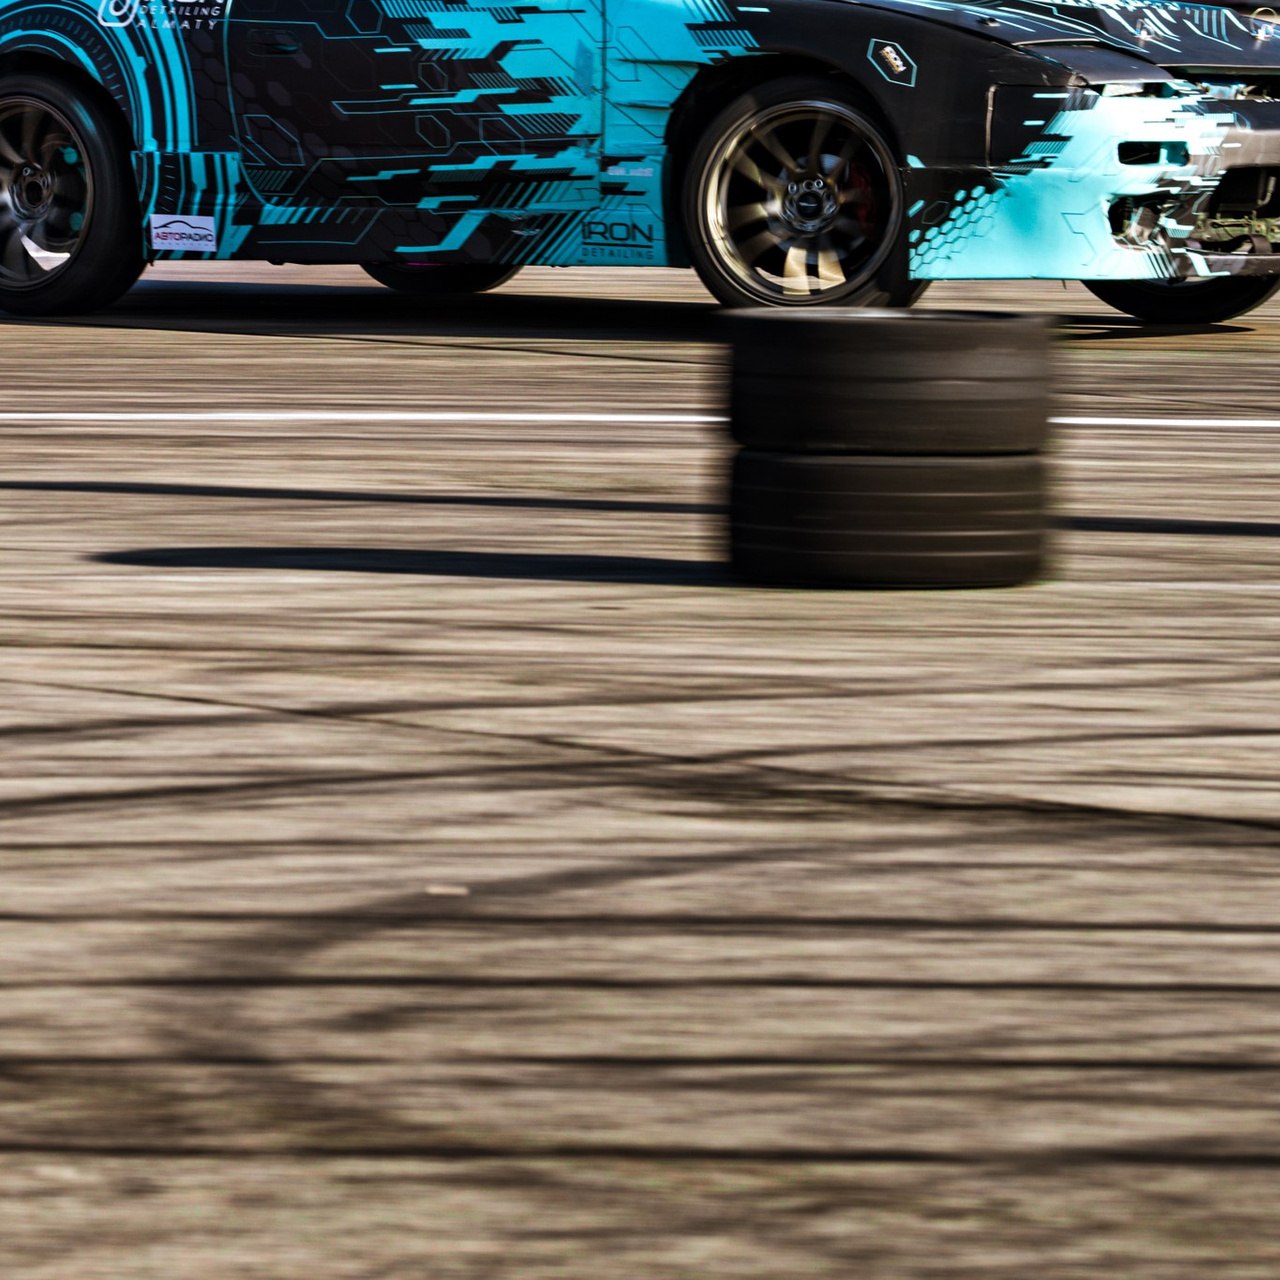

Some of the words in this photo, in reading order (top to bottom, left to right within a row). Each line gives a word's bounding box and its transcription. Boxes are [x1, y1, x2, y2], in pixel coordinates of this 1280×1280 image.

[139, 5, 221, 16] DETAILING
[136, 19, 218, 30] ALMATY
[581, 221, 654, 242] IRON
[581, 248, 655, 260] DETAILING
